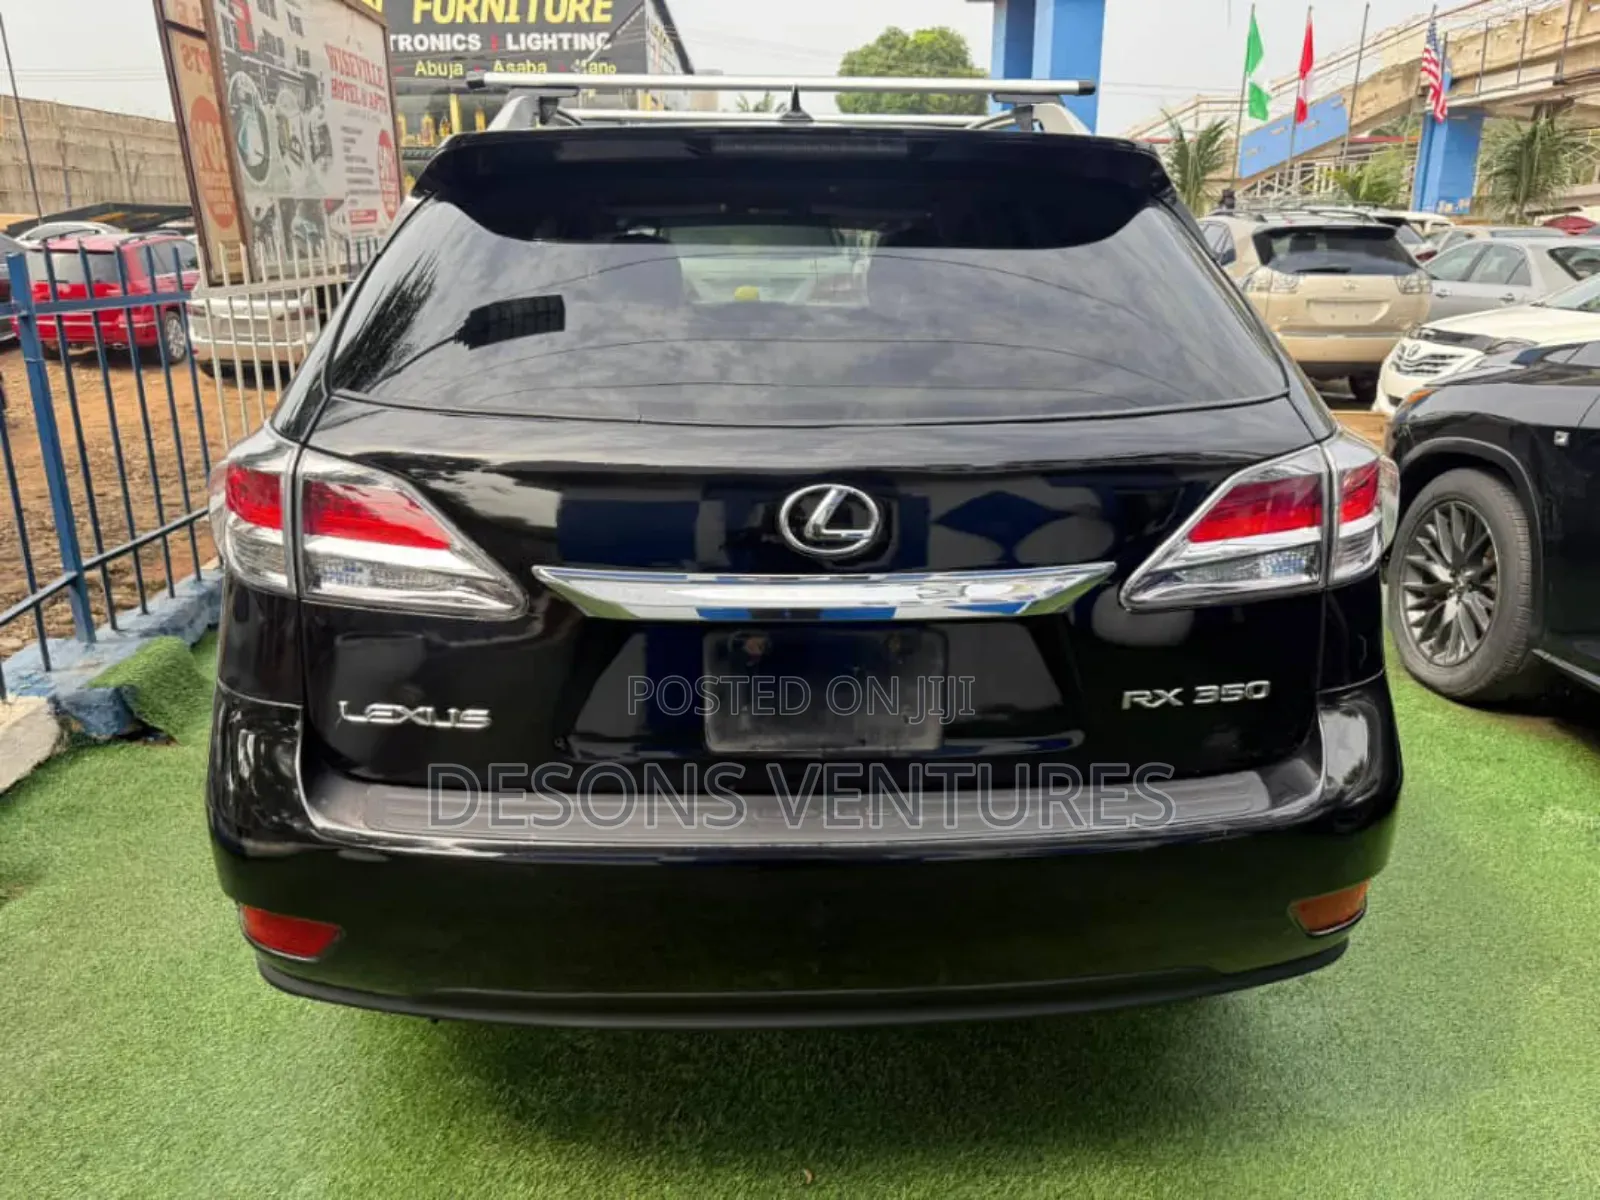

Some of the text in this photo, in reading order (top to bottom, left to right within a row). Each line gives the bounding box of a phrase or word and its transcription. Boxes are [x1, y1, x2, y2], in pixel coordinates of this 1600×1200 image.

[412, 0, 613, 24] FURNITURE
[505, 32, 612, 51] LIGHTING
[414, 60, 464, 78] Abuja
[493, 59, 547, 73] Asaba
[1122, 680, 1270, 710] RX 350
[338, 700, 492, 730] LEXUS
